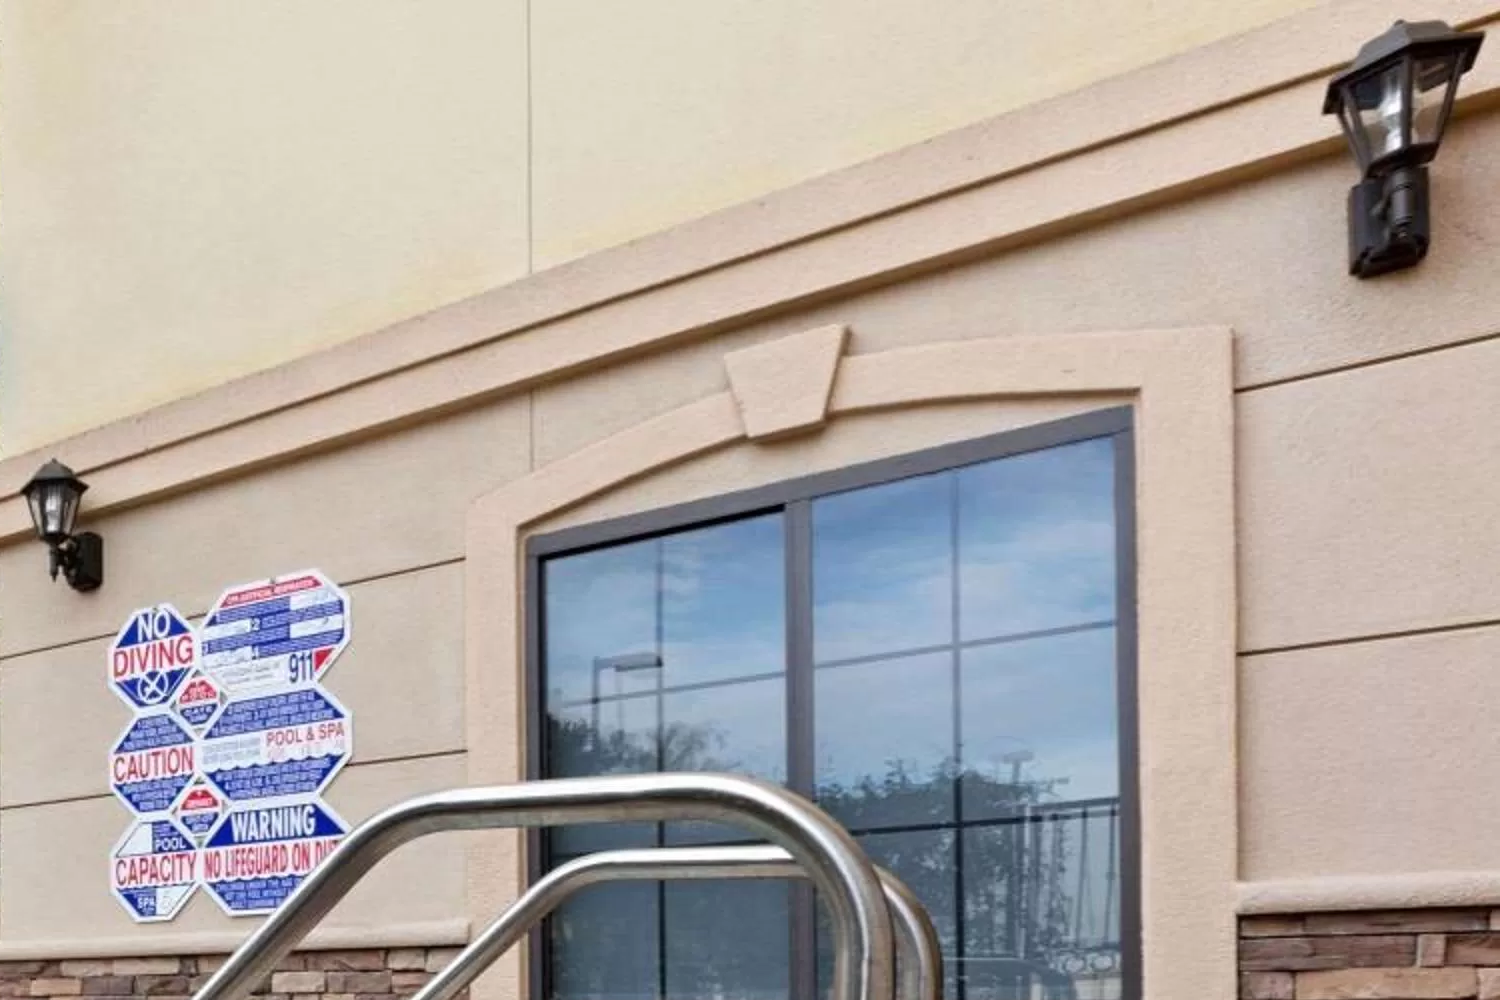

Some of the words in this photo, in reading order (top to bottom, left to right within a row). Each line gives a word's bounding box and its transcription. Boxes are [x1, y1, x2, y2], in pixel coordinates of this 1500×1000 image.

[137, 610, 170, 642] NO
[113, 635, 193, 677] DIVING
[289, 651, 313, 683] 911
[266, 728, 303, 747] POOL
[306, 726, 315, 741] &
[319, 721, 345, 740] SPA
[114, 746, 193, 782] CAUTION
[231, 805, 316, 842] WARNING
[155, 837, 187, 851] POOL
[204, 851, 221, 878] NO
[225, 845, 289, 876] LIFEGUARD
[292, 842, 310, 871] ON
[116, 852, 196, 886] CAPACITY
